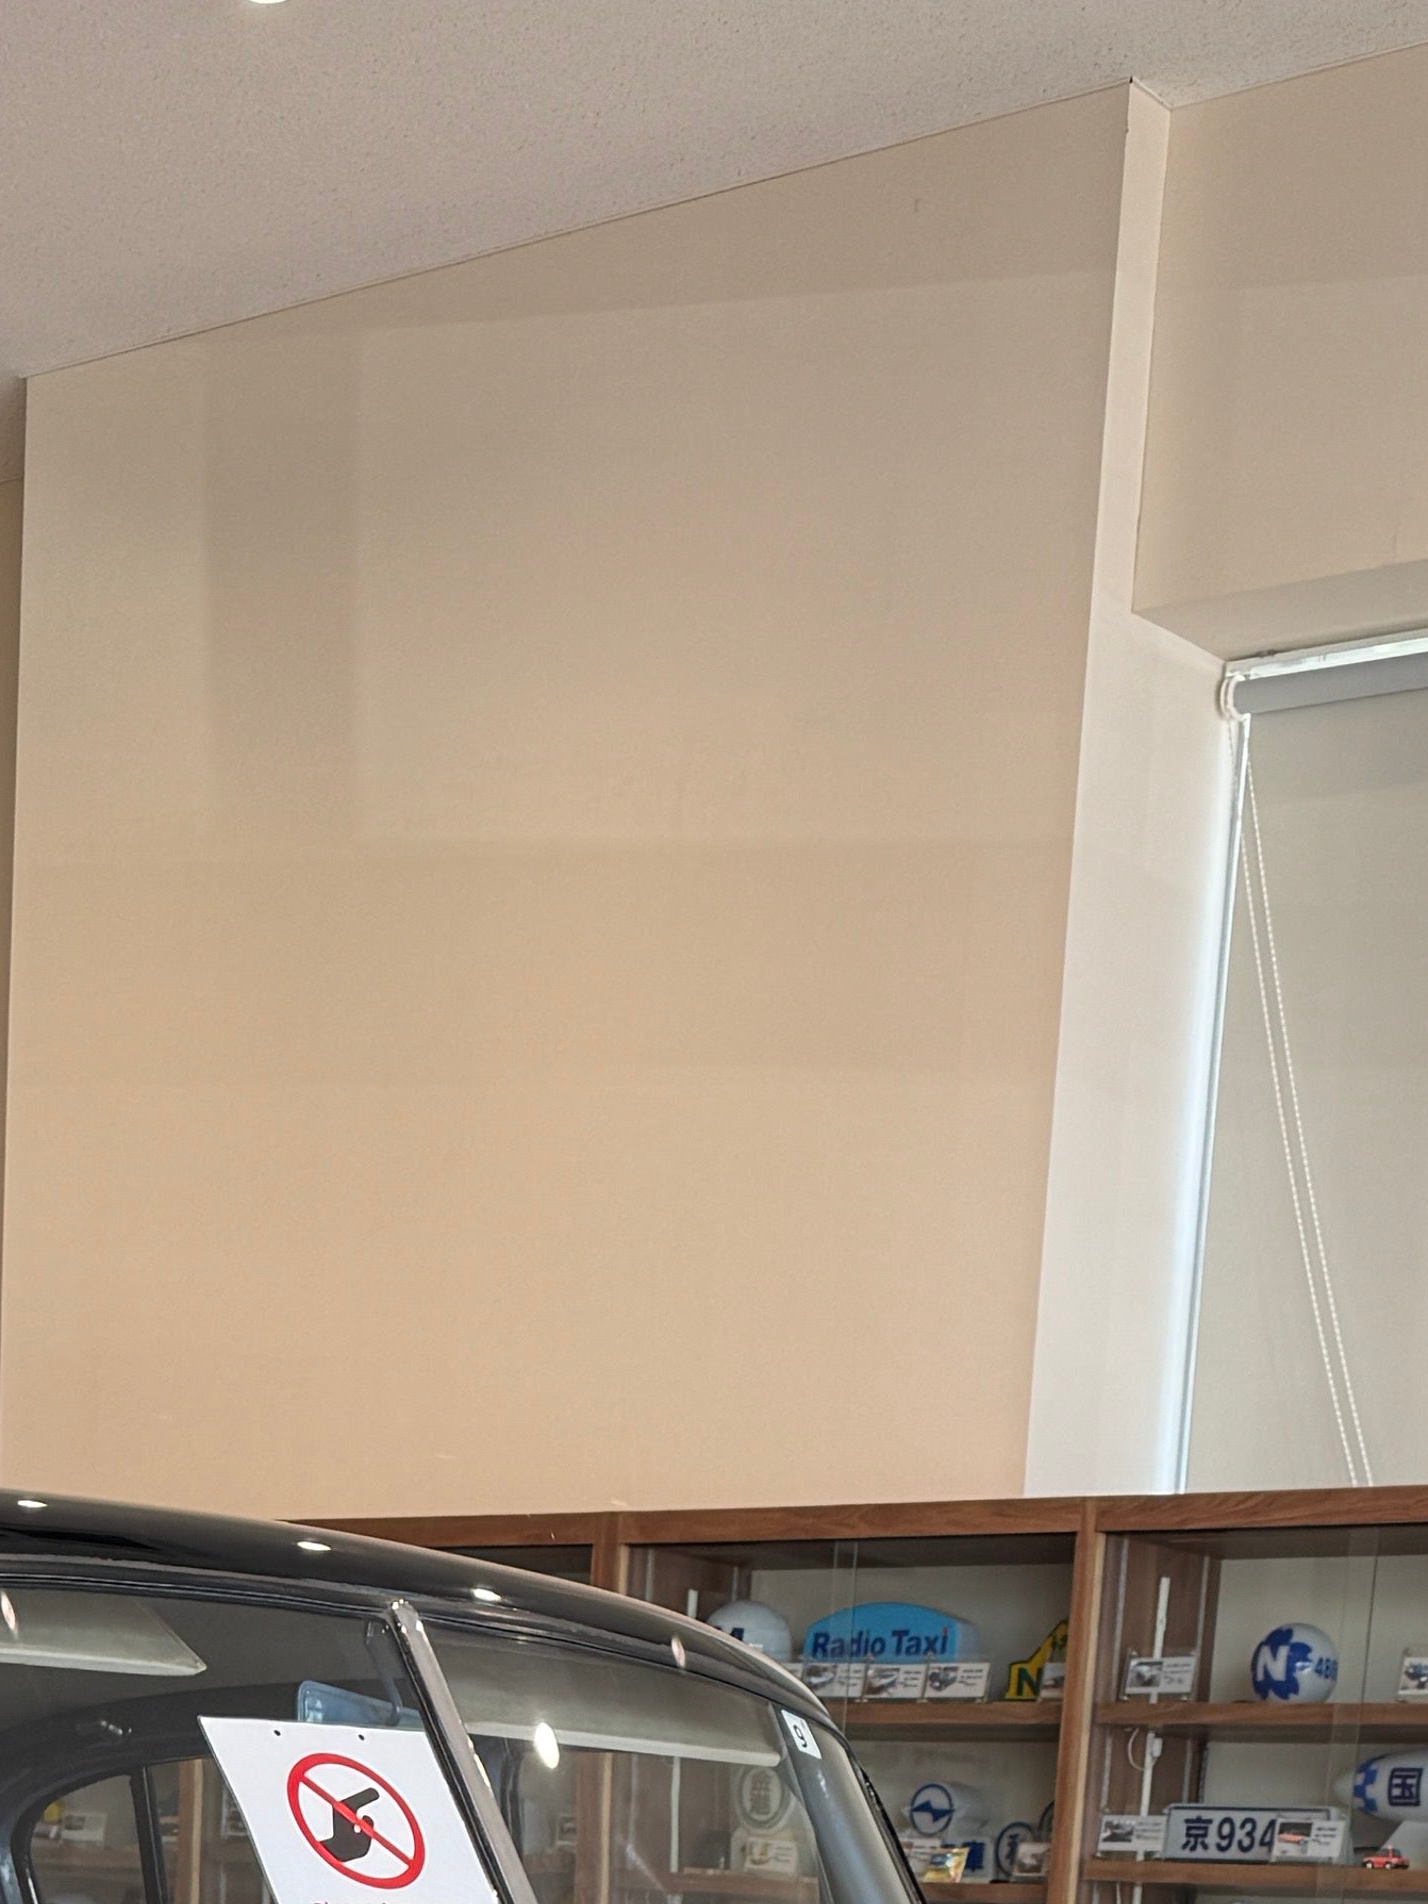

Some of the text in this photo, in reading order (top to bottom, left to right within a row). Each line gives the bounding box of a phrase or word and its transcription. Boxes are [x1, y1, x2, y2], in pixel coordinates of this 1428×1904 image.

[811, 1626, 950, 1659] Radio Taxi
[1255, 1644, 1291, 1683] N
